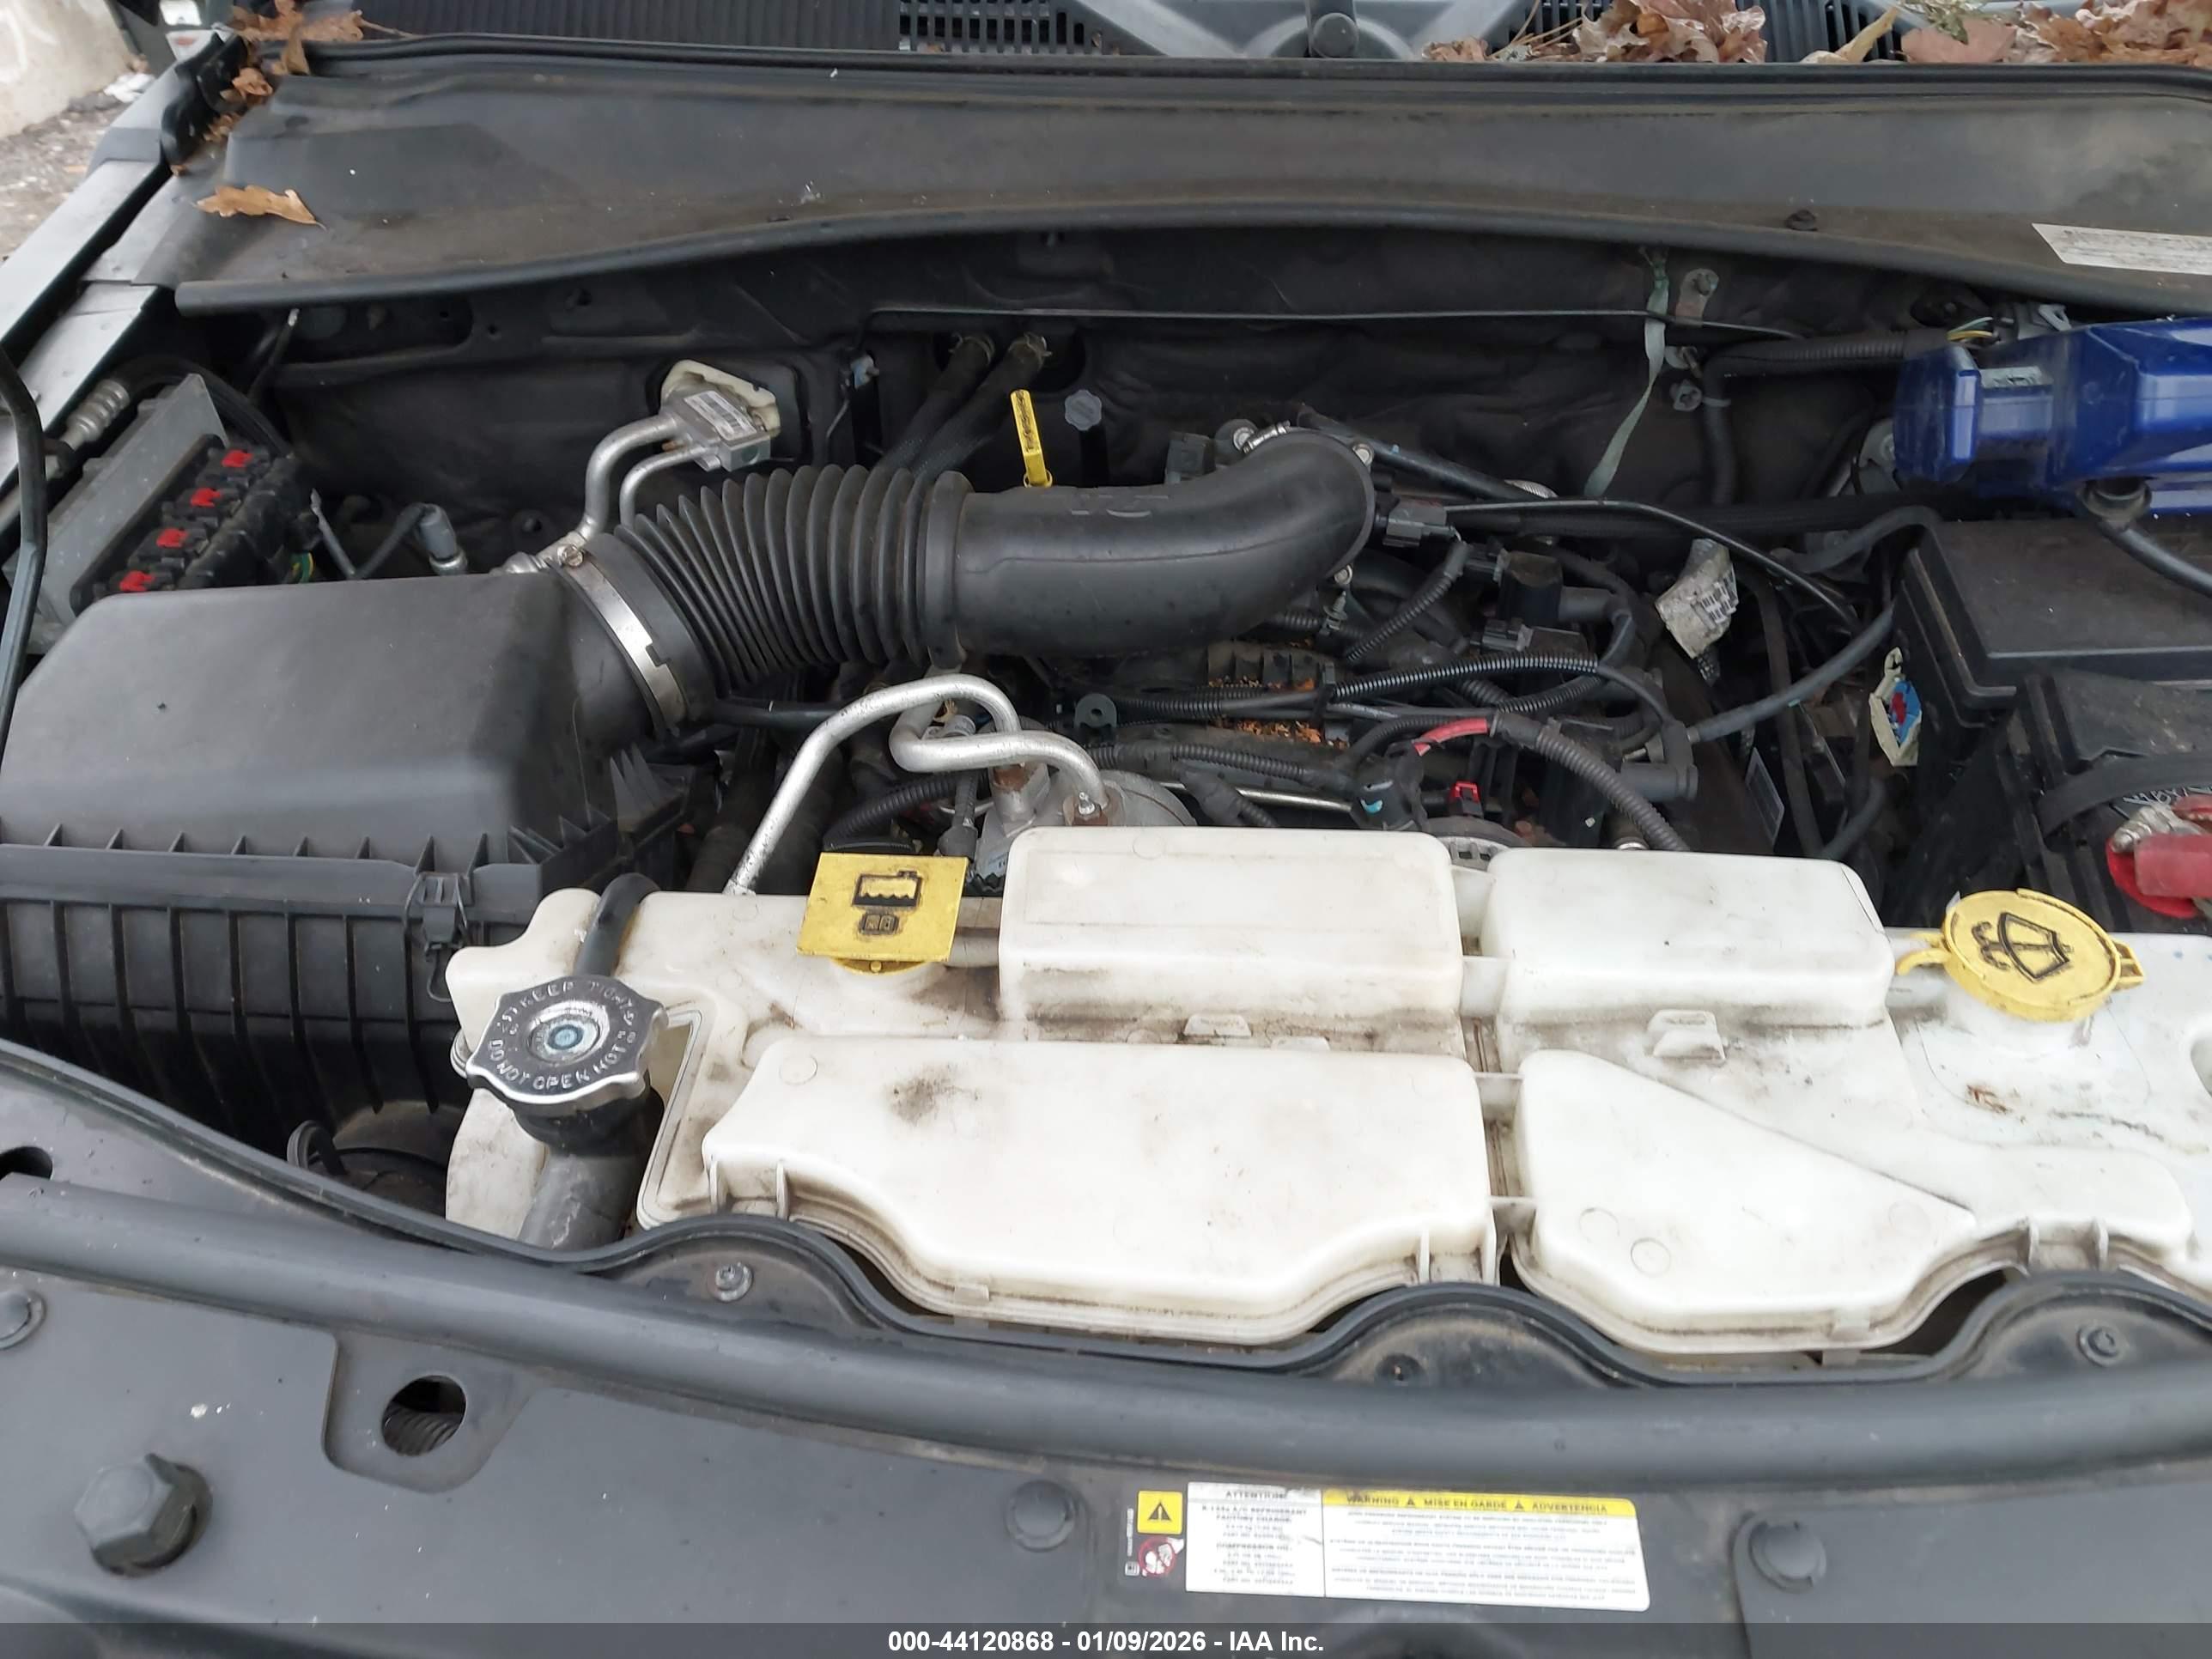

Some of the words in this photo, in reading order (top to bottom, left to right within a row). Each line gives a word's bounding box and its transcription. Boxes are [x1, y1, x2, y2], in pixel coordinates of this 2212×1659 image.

[520, 981, 574, 1007] KEEP
[488, 1039, 505, 1060] DO
[592, 1043, 627, 1075] HOT
[496, 1060, 531, 1085] NOT
[532, 1070, 591, 1091] OPEN
[1347, 1496, 1399, 1505] WARNING
[1425, 1498, 1450, 1507] MISE
[1454, 1499, 1468, 1508] EN
[1470, 1500, 1507, 1509] GARDE
